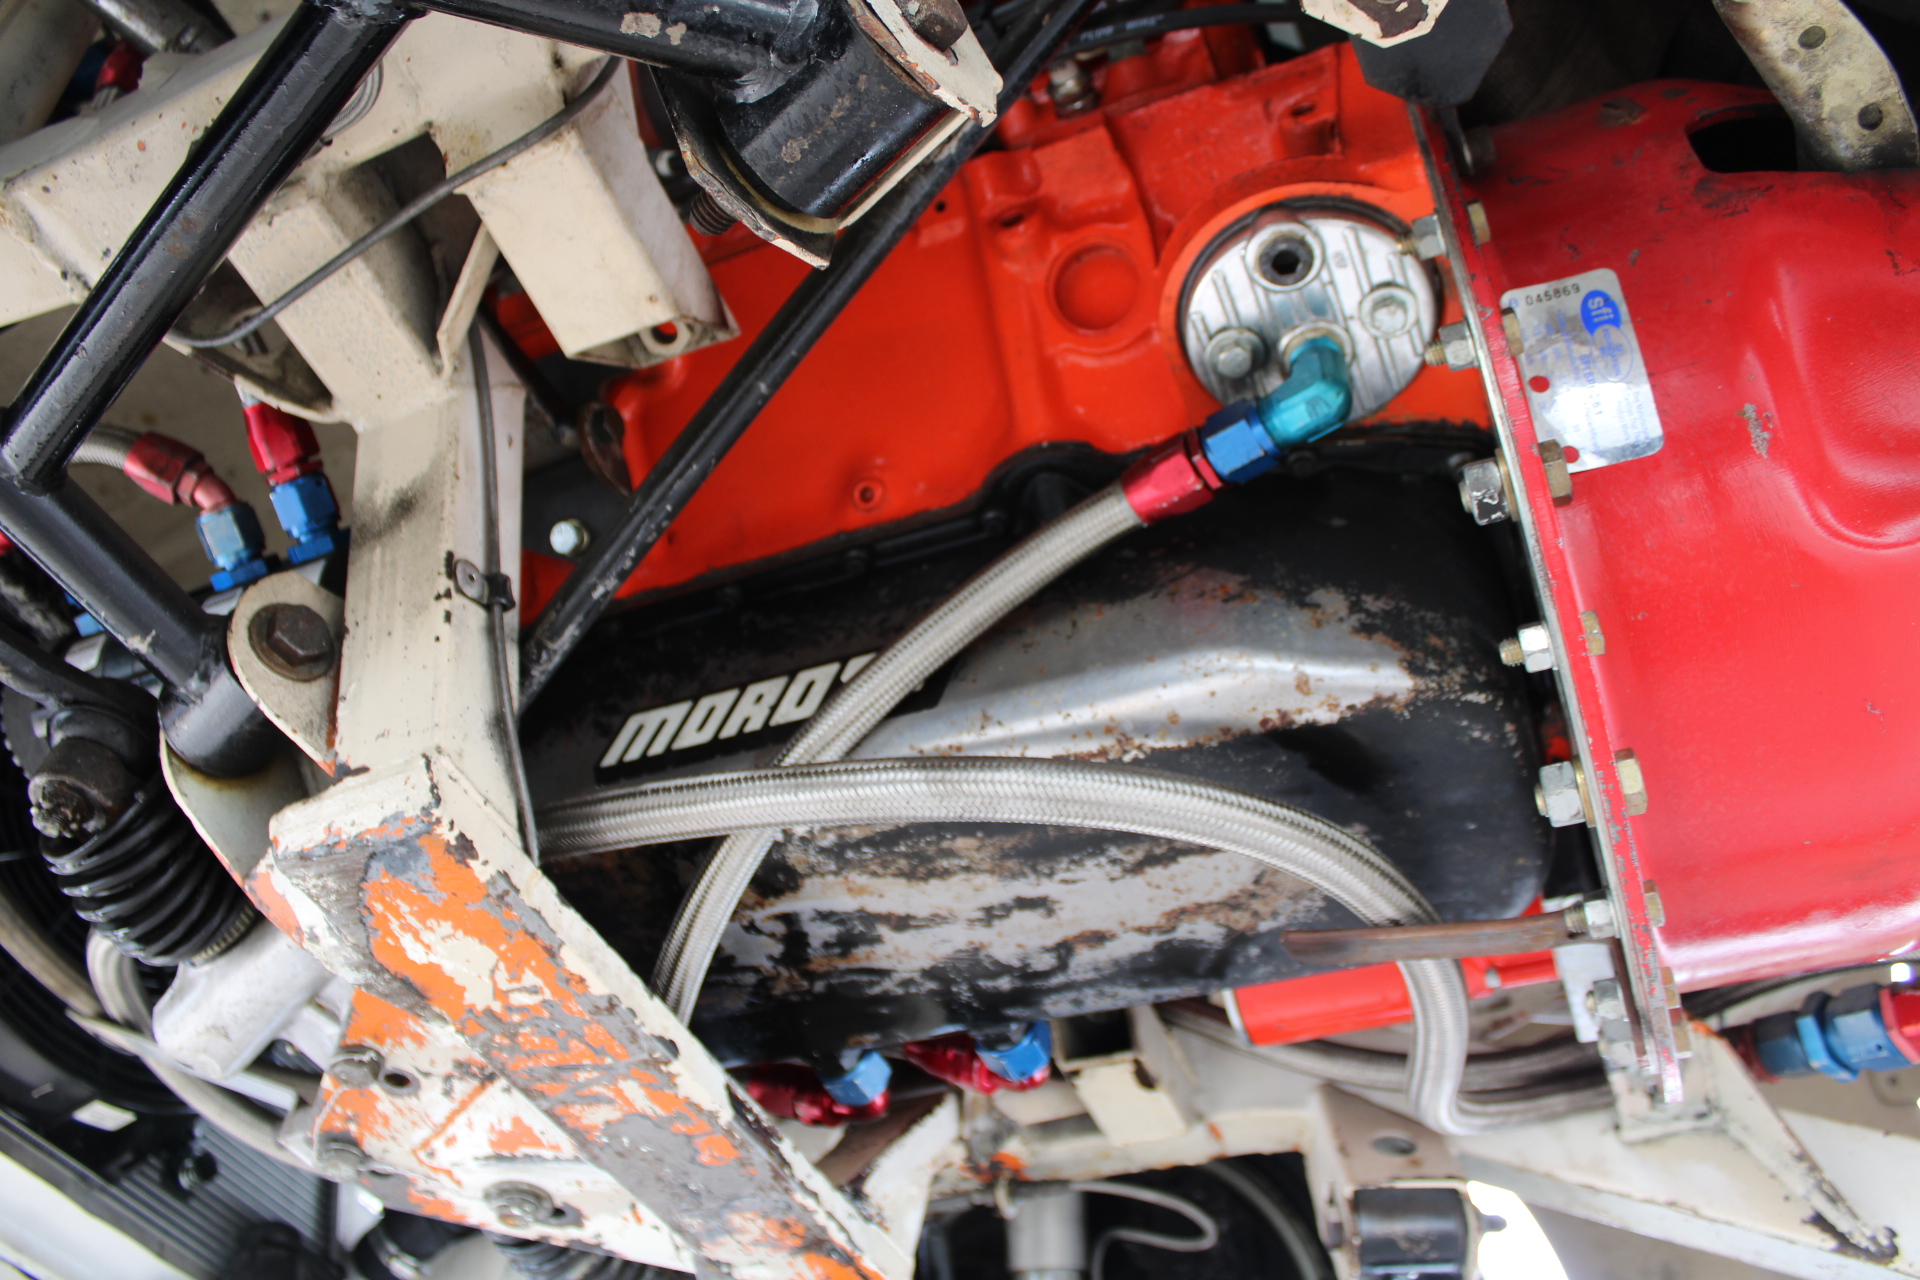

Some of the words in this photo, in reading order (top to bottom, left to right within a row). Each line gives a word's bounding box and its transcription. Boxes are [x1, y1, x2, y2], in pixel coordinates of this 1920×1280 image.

[1525, 283, 1581, 306] 045869
[1586, 294, 1614, 322] sfi
[599, 652, 922, 768] MORO
